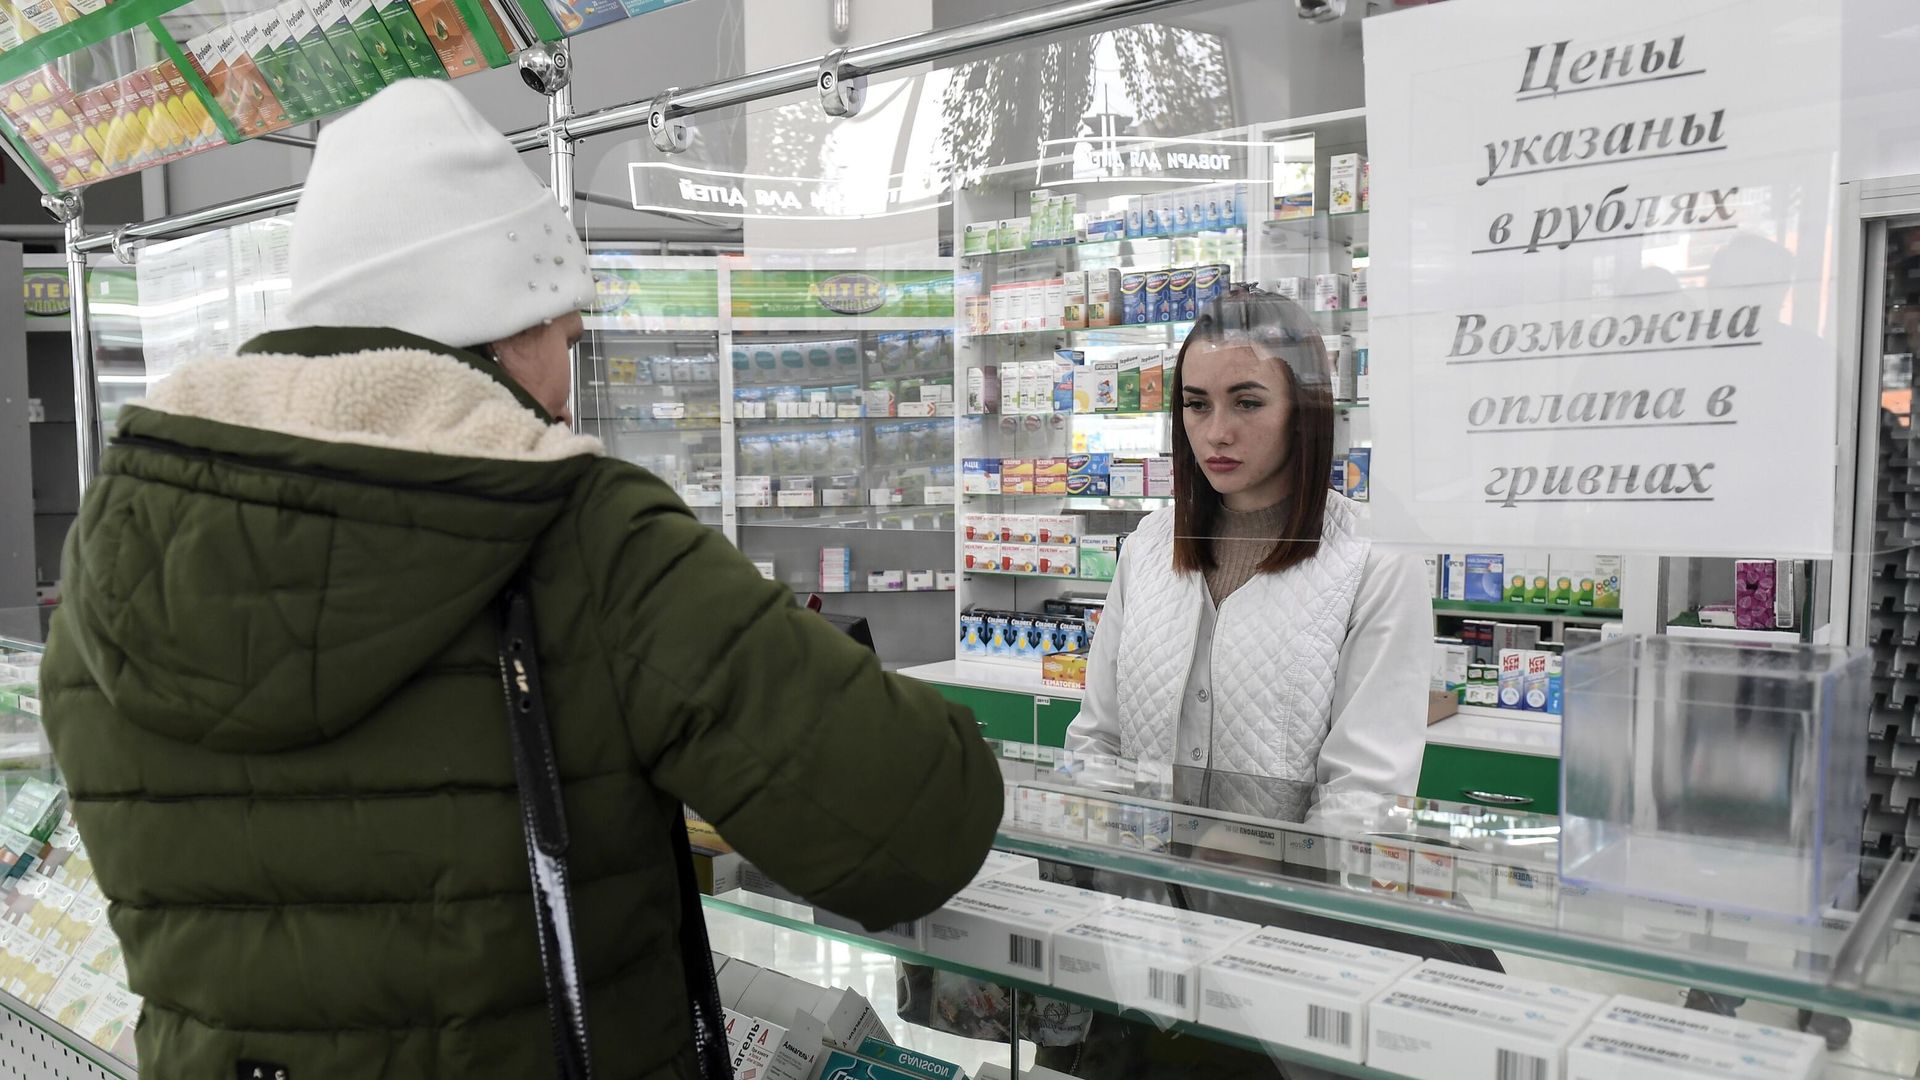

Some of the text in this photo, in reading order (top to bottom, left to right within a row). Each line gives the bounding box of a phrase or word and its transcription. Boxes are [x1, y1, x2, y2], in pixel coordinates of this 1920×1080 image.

[1516, 34, 1687, 98] Цены
[1476, 109, 1726, 187] указаны
[1488, 184, 1740, 255] в рублях
[1445, 303, 1763, 360] Возможна
[1467, 384, 1737, 427] оплата в
[1484, 461, 1715, 508] гривнах
[1503, 653, 1520, 666] Кси
[1503, 664, 1520, 673] лен
[1528, 656, 1546, 668] Кси
[1528, 666, 1545, 675] лен
